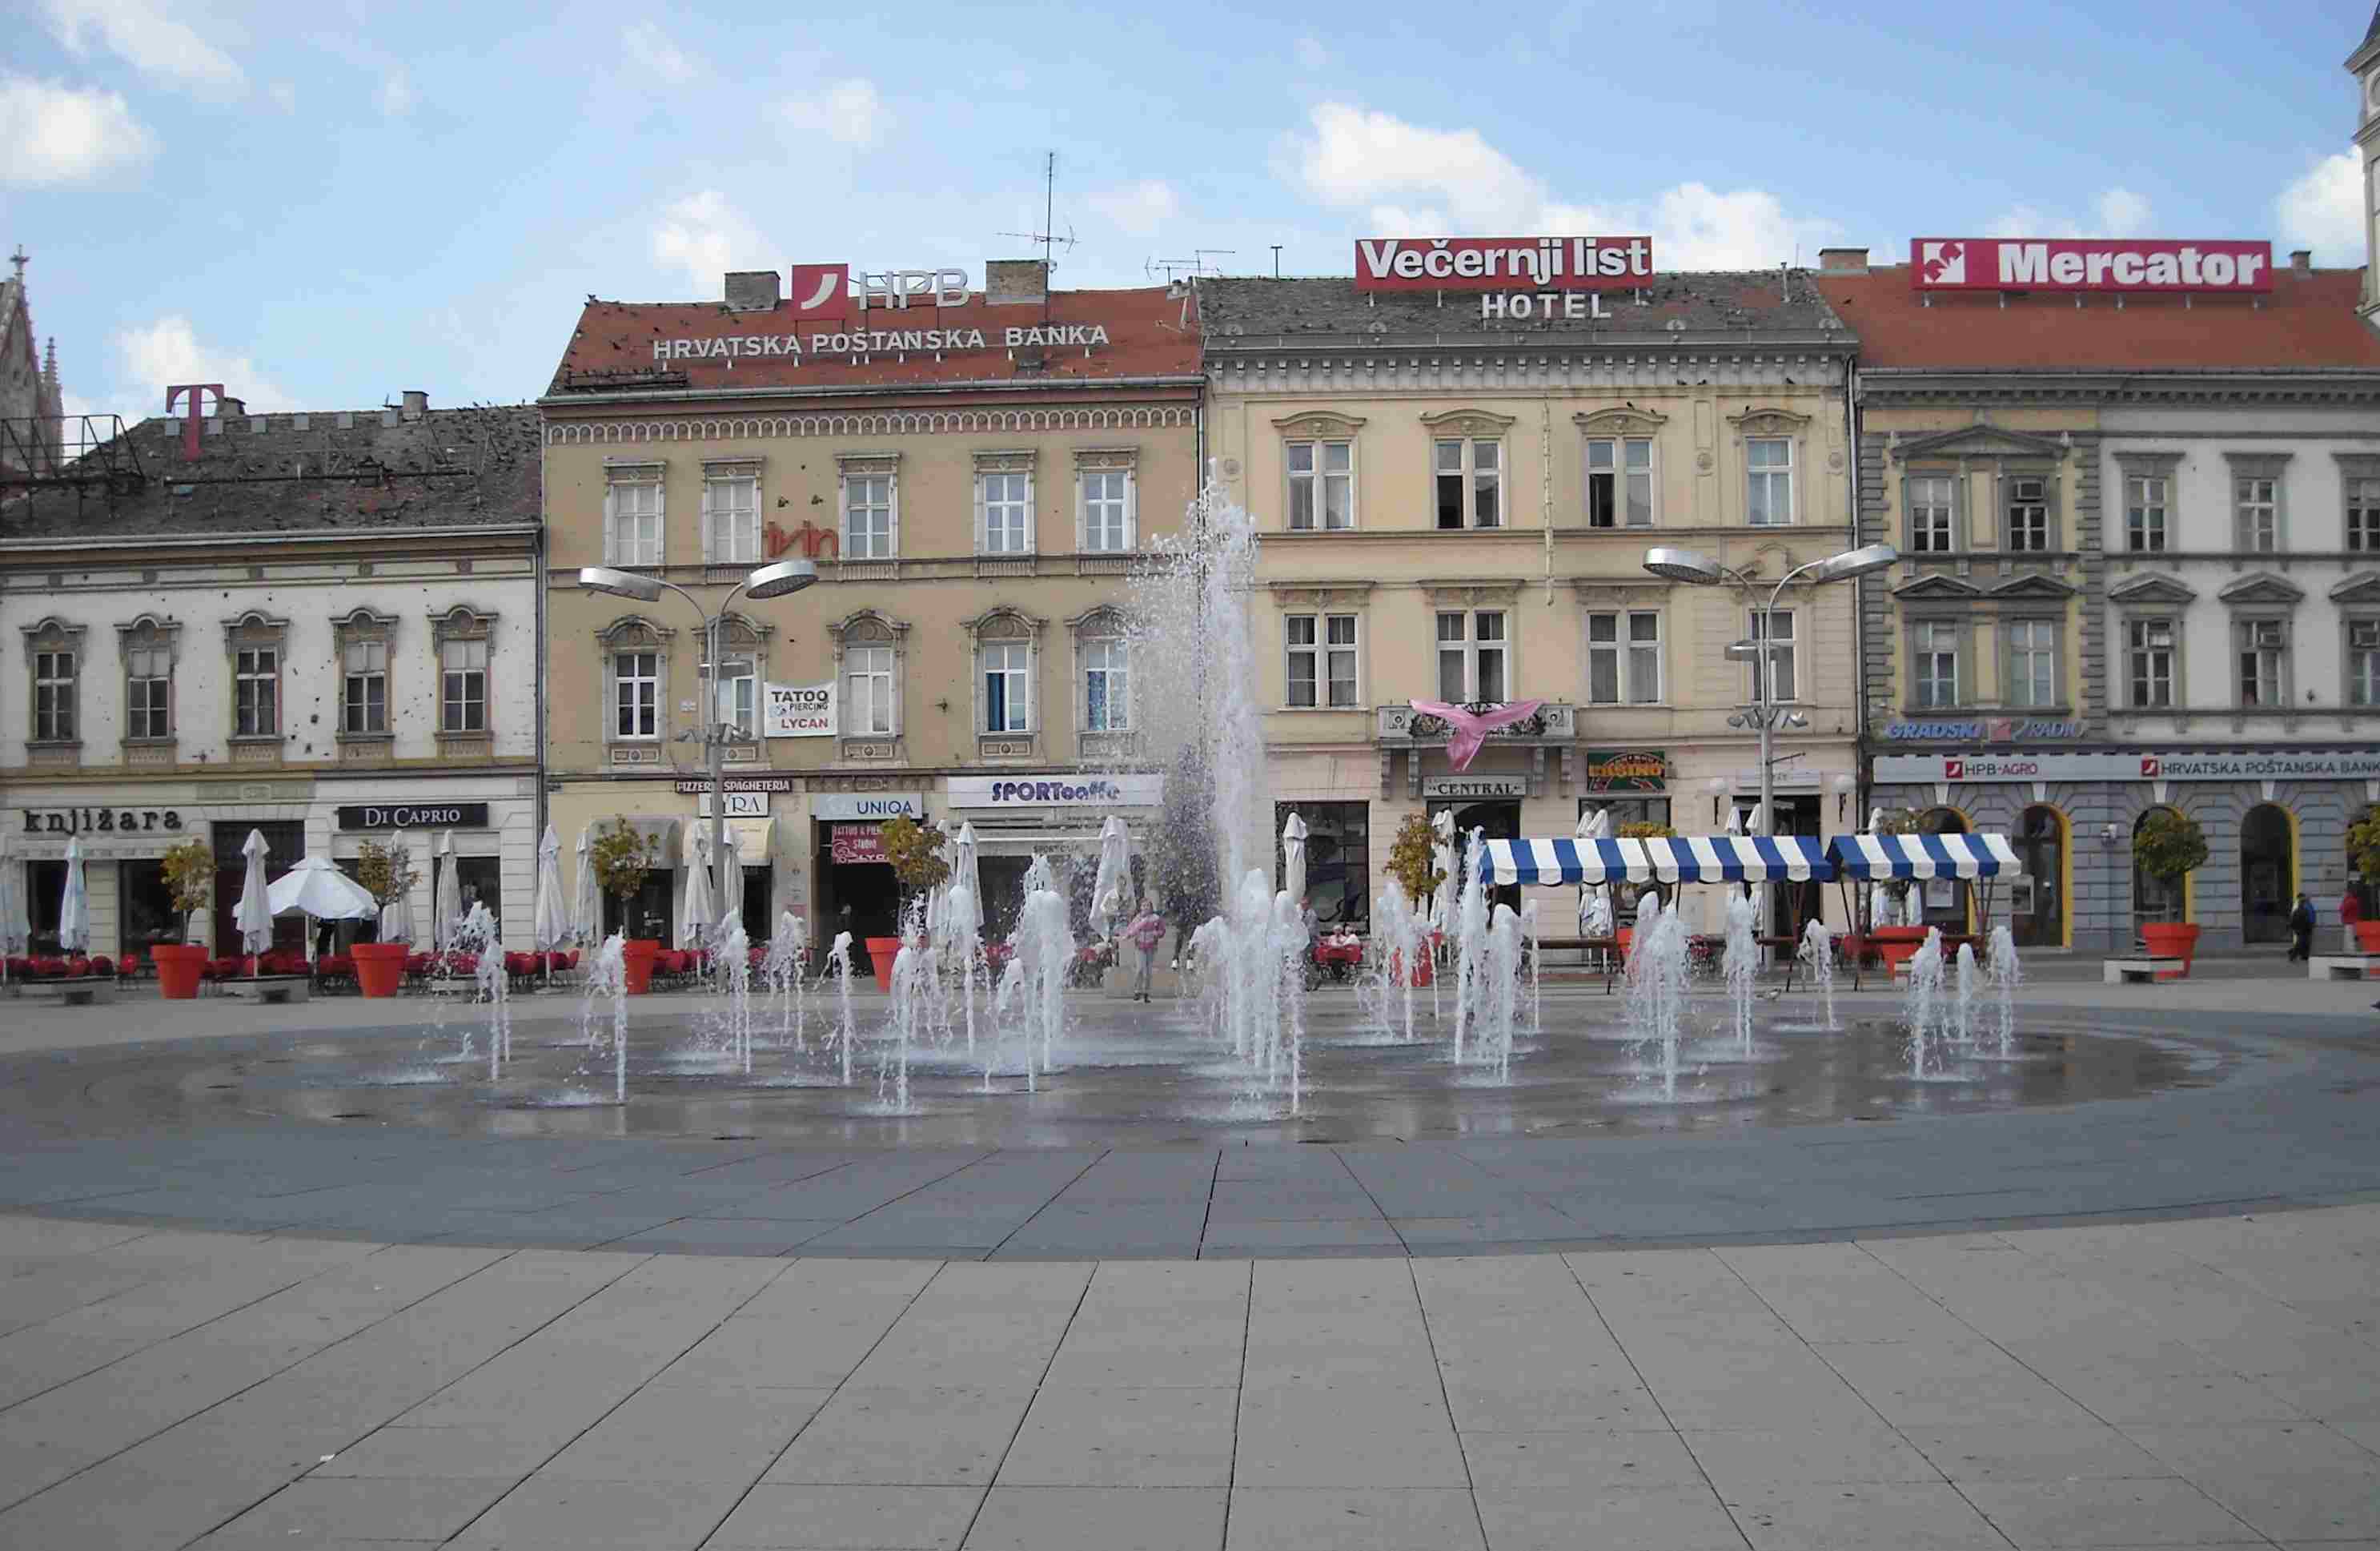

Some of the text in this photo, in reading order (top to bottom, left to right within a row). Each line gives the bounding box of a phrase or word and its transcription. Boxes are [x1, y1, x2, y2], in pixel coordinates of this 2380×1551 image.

[1360, 238, 1650, 285] Večernji list
[1998, 243, 2264, 286] Mercator
[858, 268, 970, 310] HPB
[1481, 293, 1612, 319] HOTEL
[652, 323, 1110, 360] HRVATSKA POŠTANSKA BANKA
[770, 690, 829, 703] TATOO
[789, 702, 828, 712] PIERCING
[781, 718, 829, 729] LYCAN
[2161, 758, 2380, 776] HRVATSKA POŠTANSKA BANK
[676, 779, 790, 792] PIZZER SPAGHETERIA
[1438, 783, 1511, 794] CENTRAL
[857, 800, 913, 814] UNIQA
[22, 808, 183, 836] knjižara
